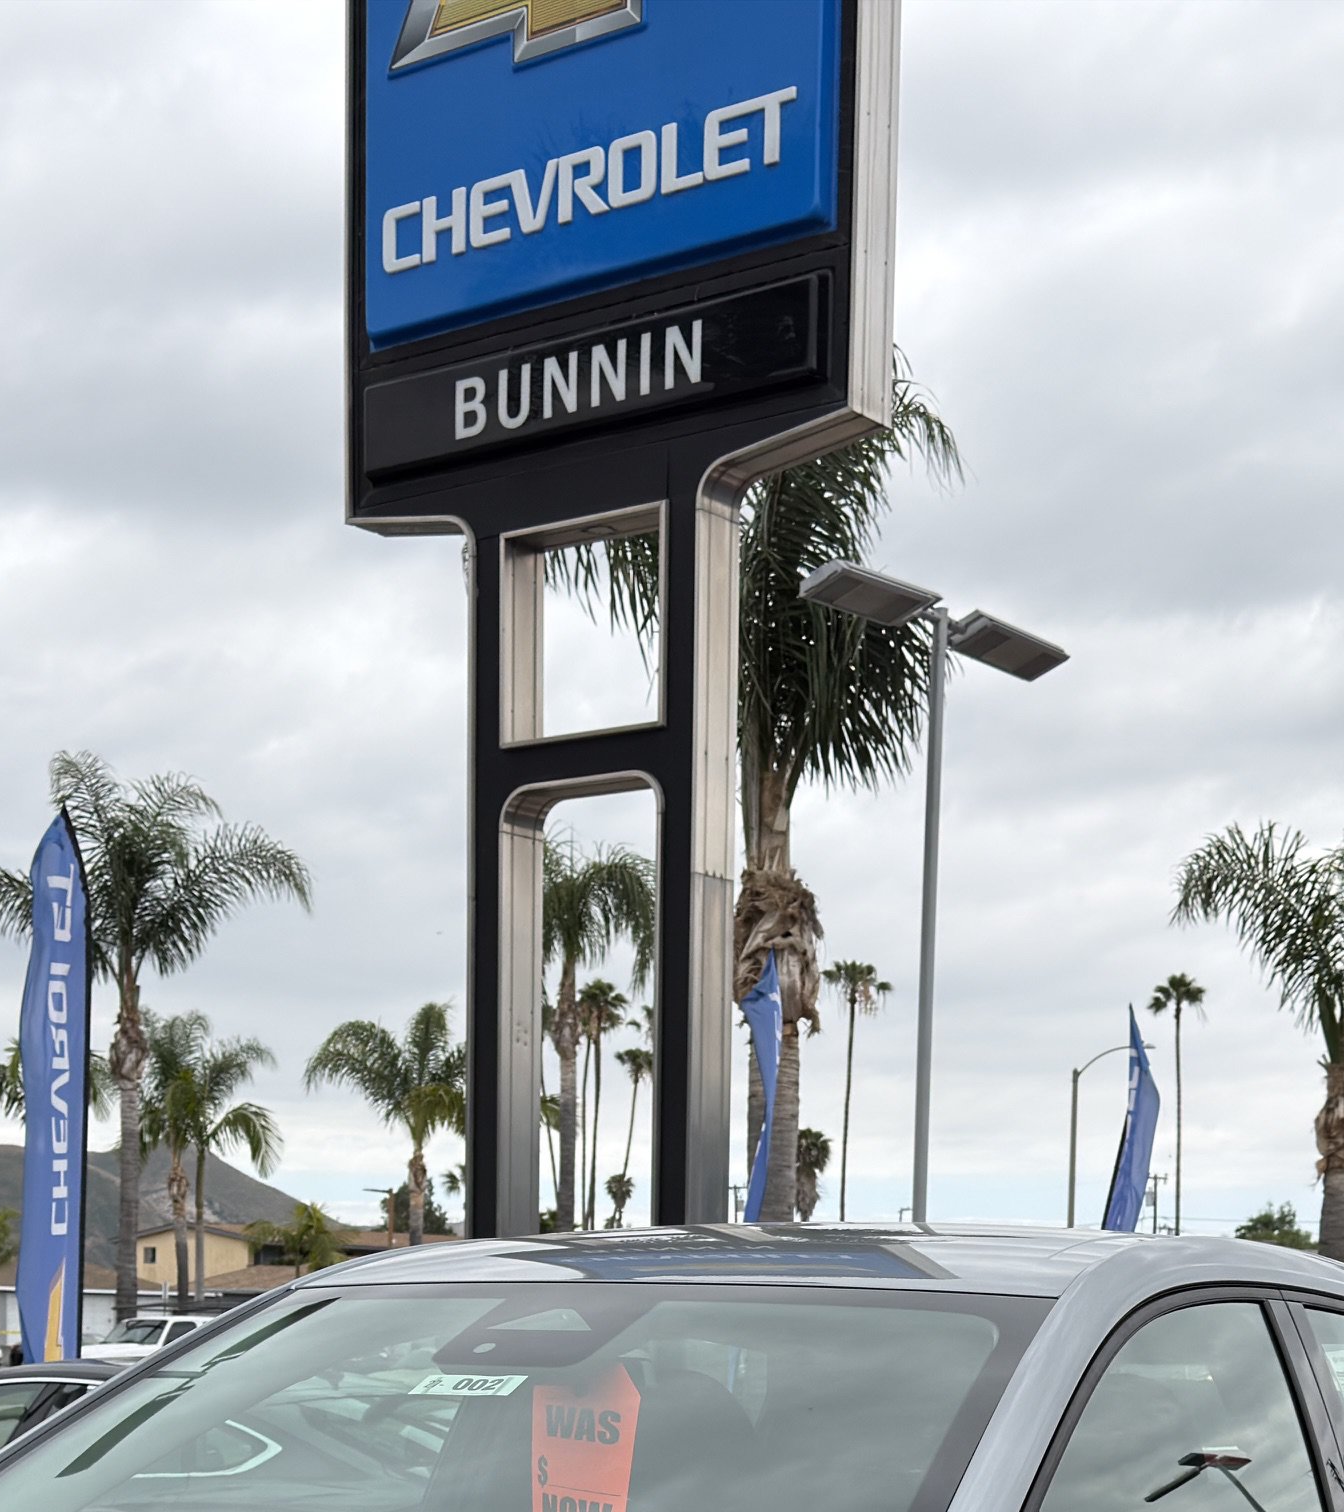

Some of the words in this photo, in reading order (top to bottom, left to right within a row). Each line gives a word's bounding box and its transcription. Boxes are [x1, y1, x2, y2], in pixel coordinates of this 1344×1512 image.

[382, 86, 797, 274] CHEVROLET
[456, 319, 702, 440] BUNNIN
[452, 1378, 504, 1391] 002
[546, 1404, 621, 1445] WAS
[538, 1455, 548, 1487] $
